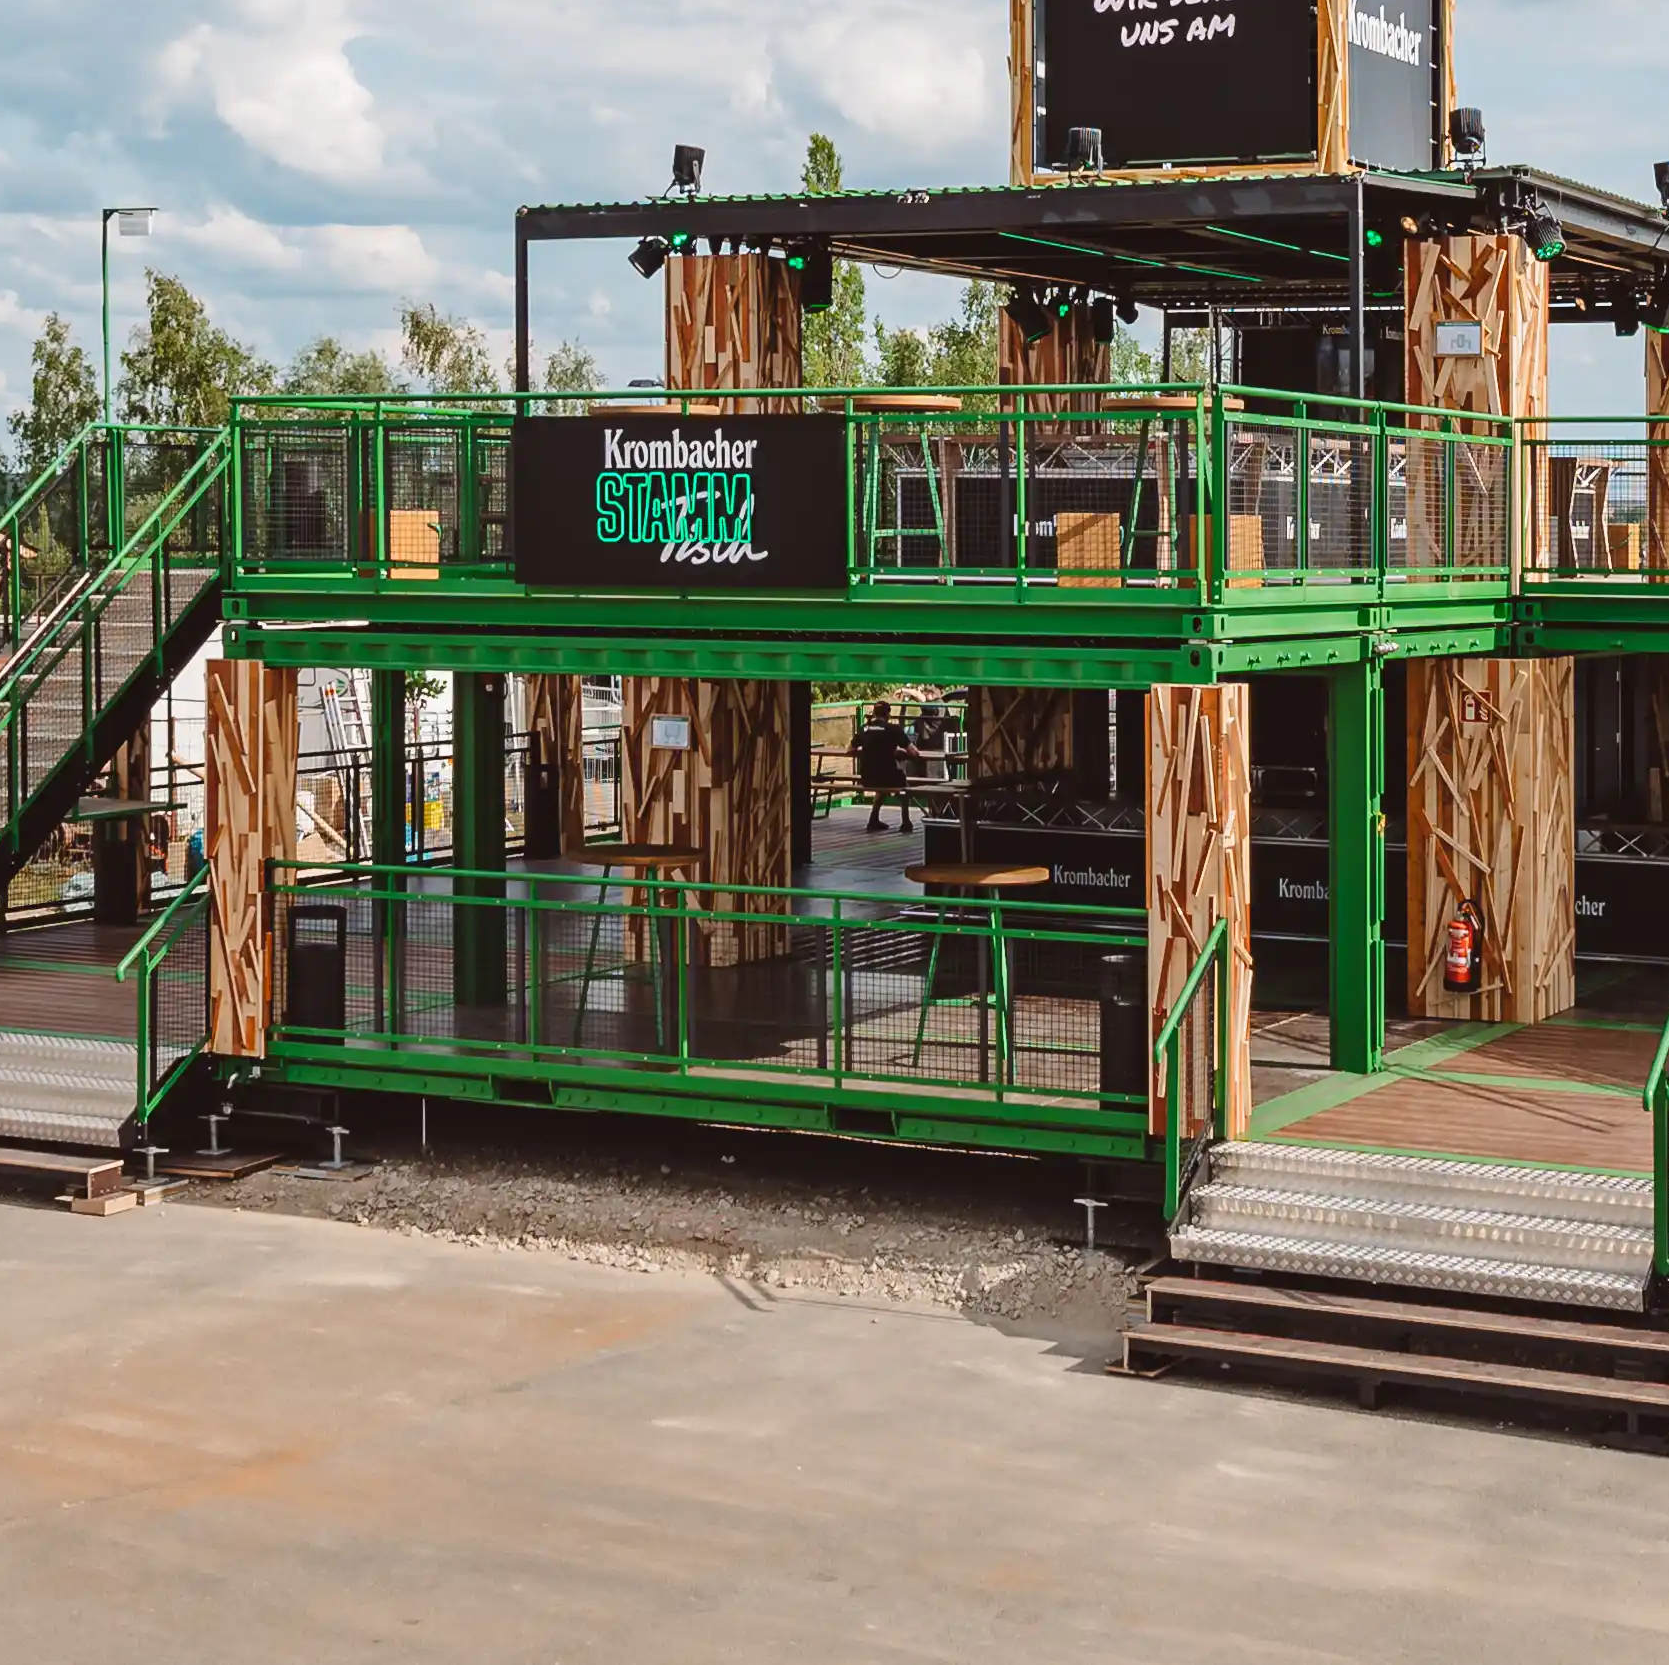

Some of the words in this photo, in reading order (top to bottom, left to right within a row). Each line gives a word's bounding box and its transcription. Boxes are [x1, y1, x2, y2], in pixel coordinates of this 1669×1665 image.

[1120, 18, 1179, 47] UNS
[1186, 13, 1236, 41] AM
[604, 428, 758, 469] Krombacher
[596, 472, 752, 544] STAMM
[1053, 864, 1131, 888] Krombacher
[1575, 895, 1605, 916] cher
